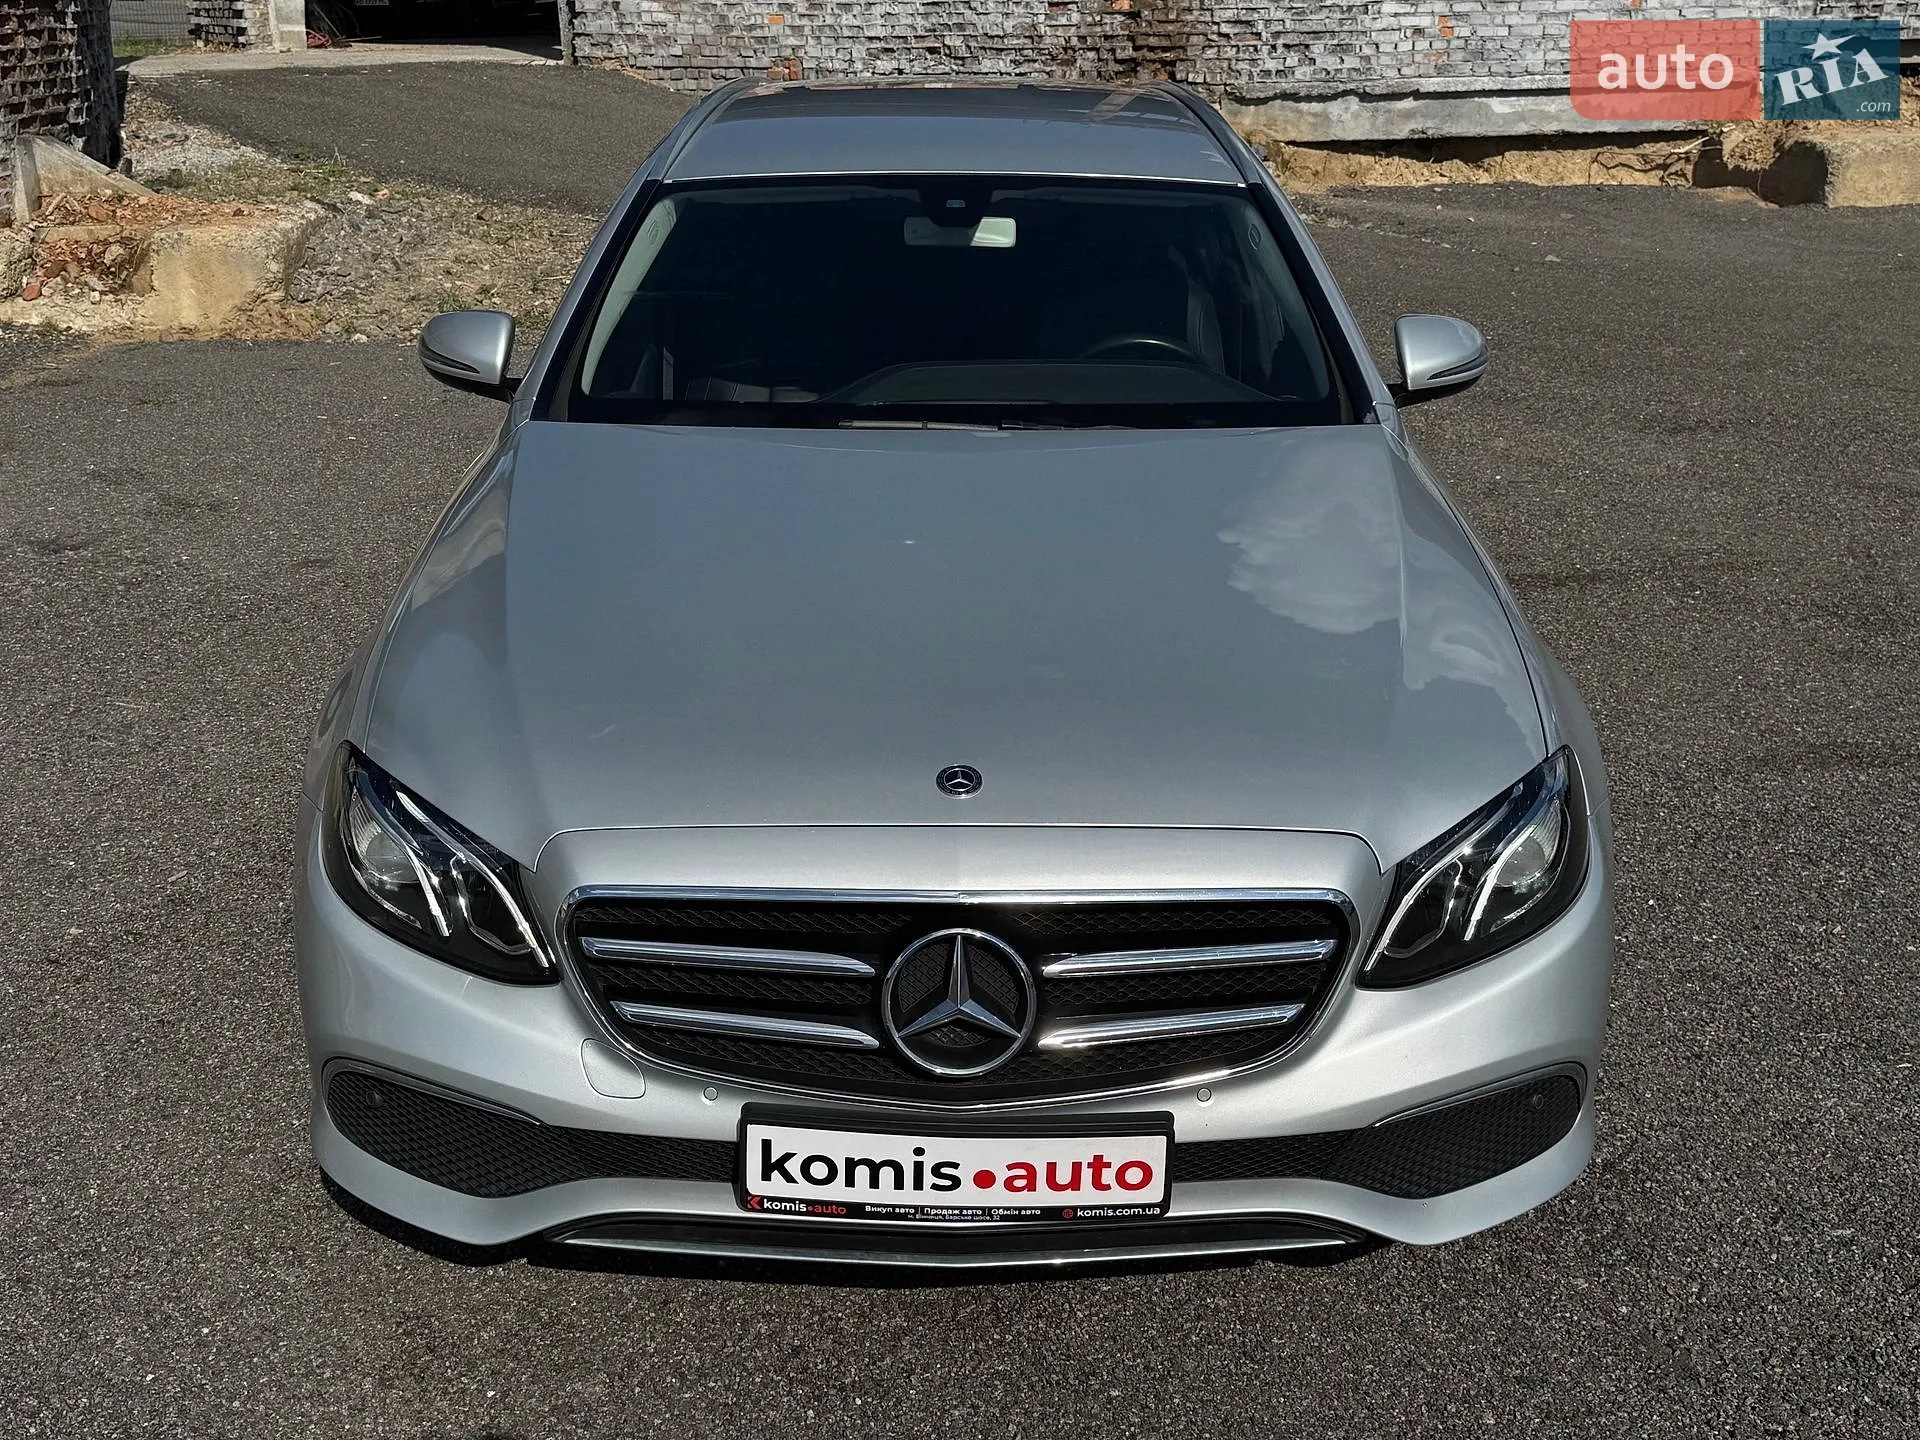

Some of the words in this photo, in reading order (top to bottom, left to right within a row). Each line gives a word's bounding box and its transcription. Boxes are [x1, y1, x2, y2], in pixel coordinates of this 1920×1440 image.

[865, 1205, 893, 1214] Викуп
[924, 1208, 960, 1216] Продаж
[1077, 1206, 1161, 1217] komis.com.ua
